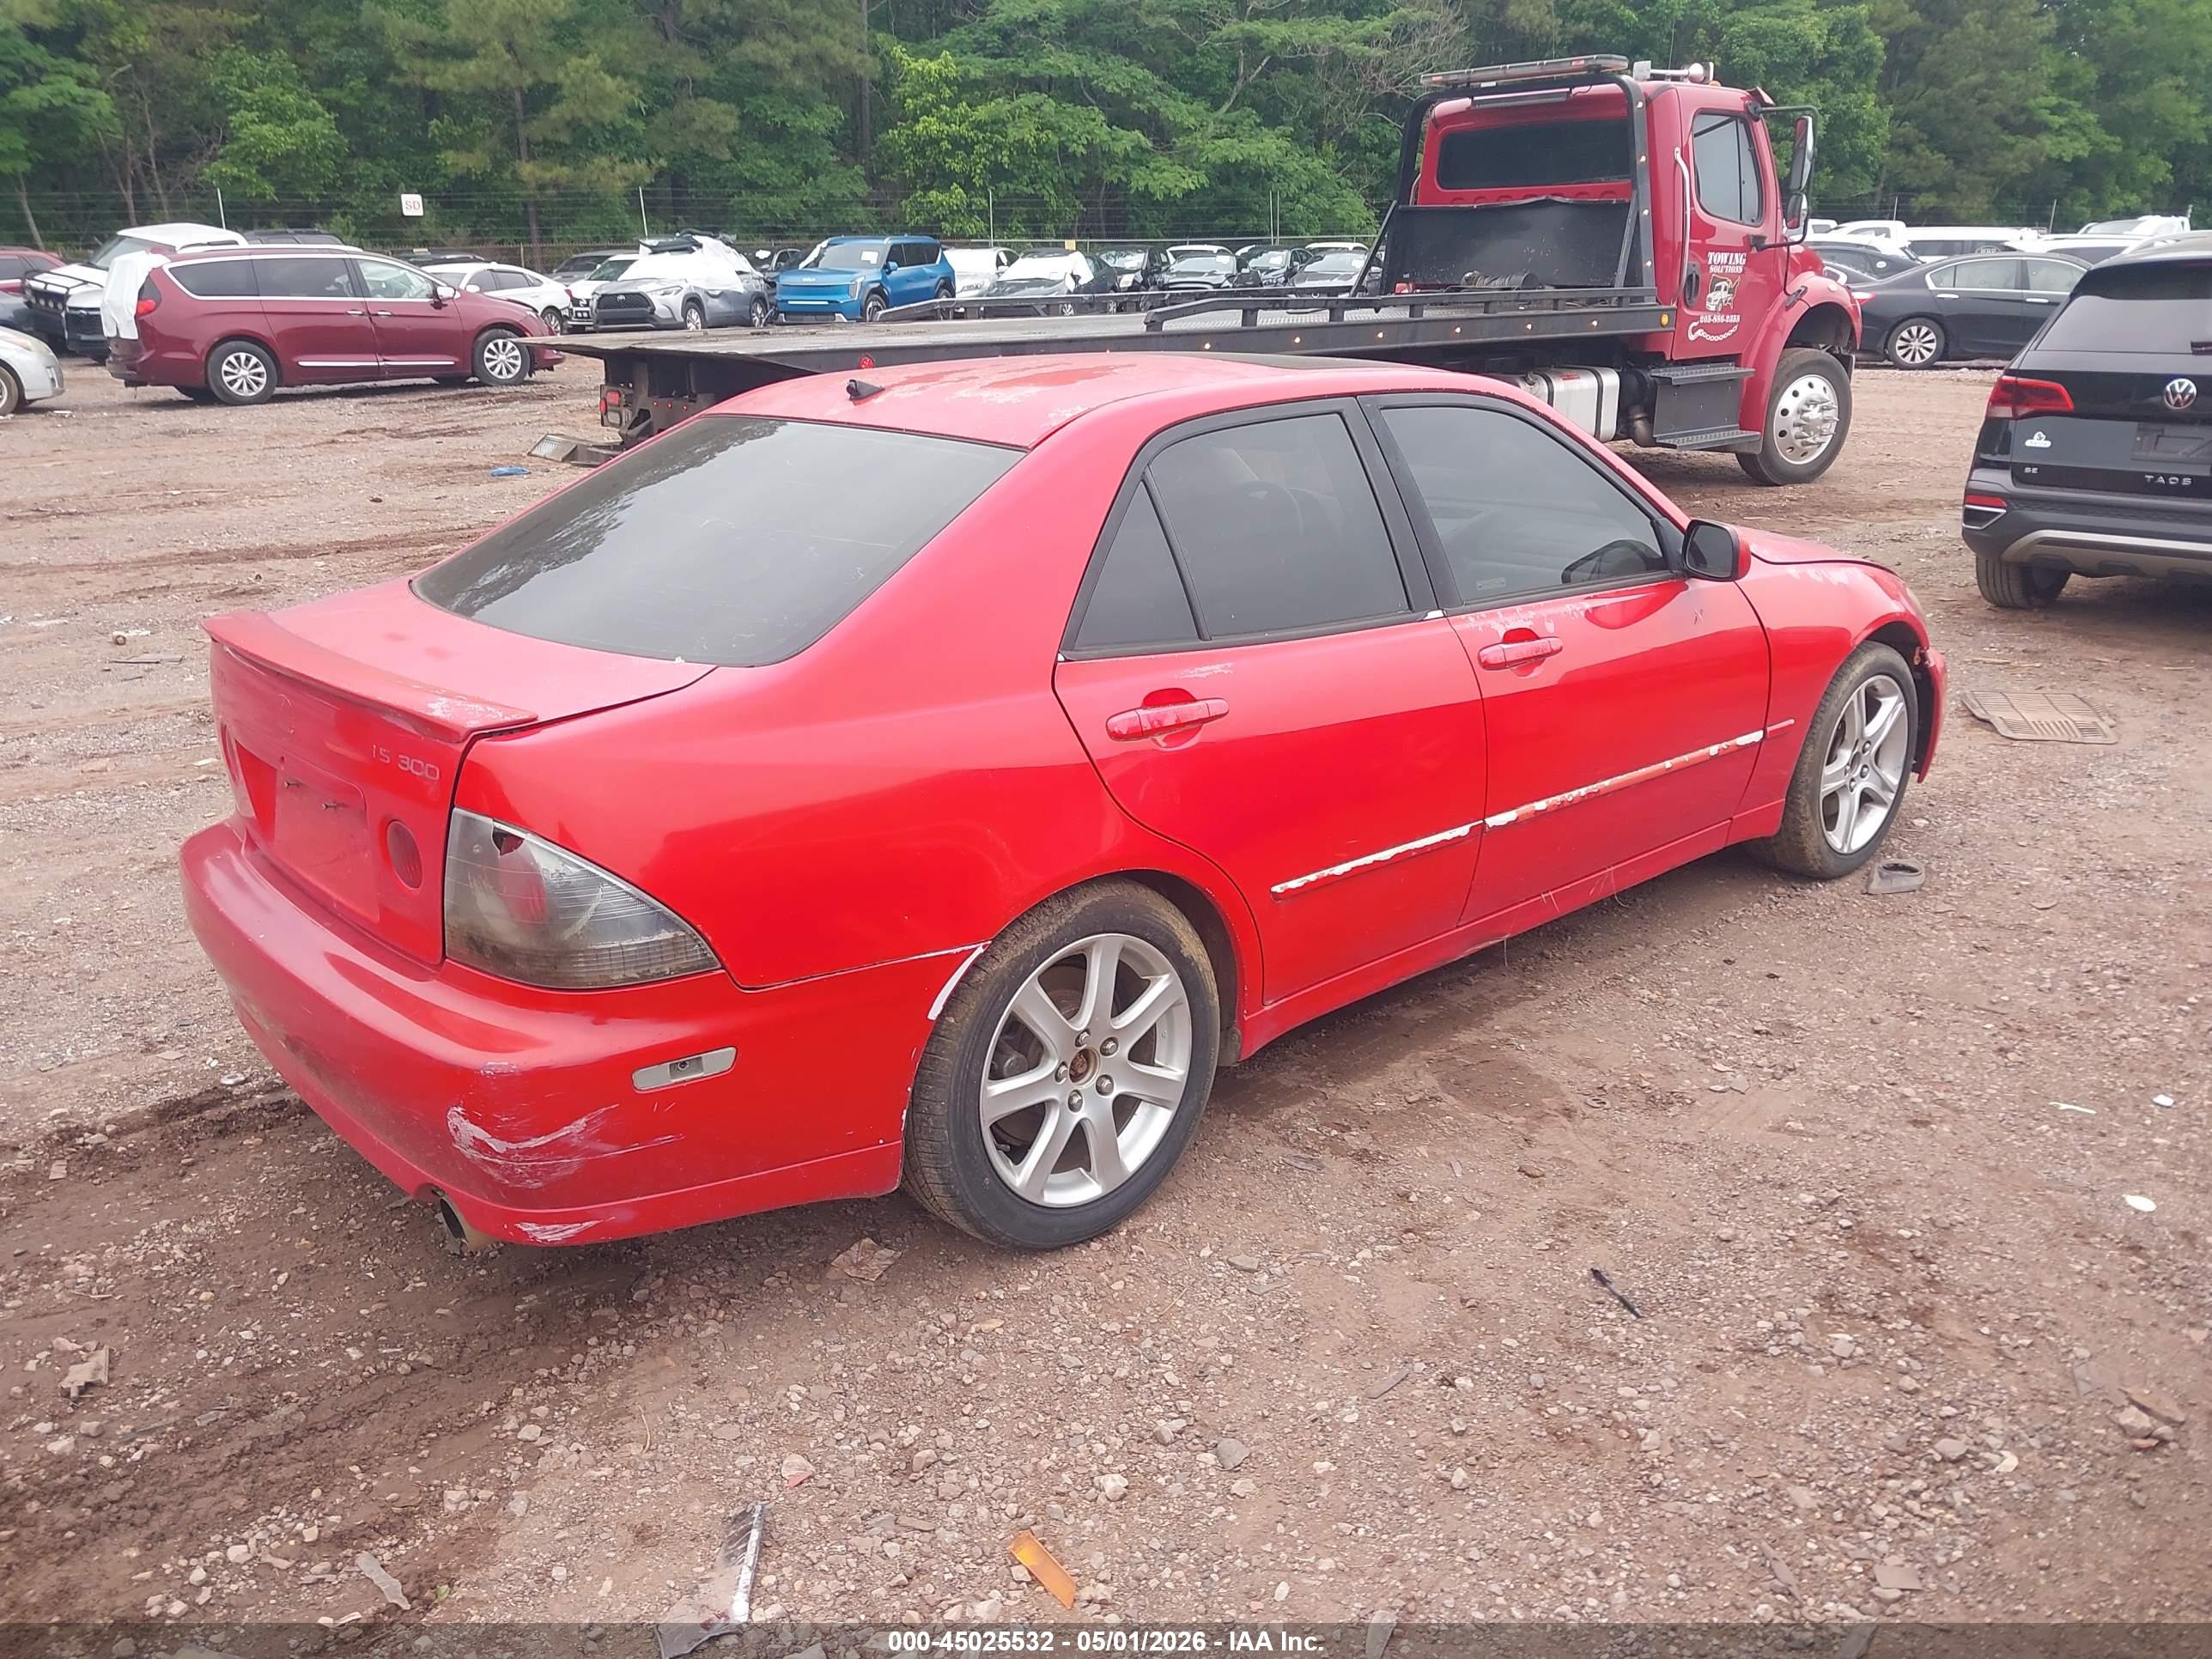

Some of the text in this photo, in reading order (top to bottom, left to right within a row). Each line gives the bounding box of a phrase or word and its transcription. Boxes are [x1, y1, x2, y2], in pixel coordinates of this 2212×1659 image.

[1708, 252, 1746, 264] TOWING
[1710, 264, 1742, 273] SOLUTIONS
[2144, 474, 2192, 486] TAOS
[373, 744, 440, 781] IS 300
